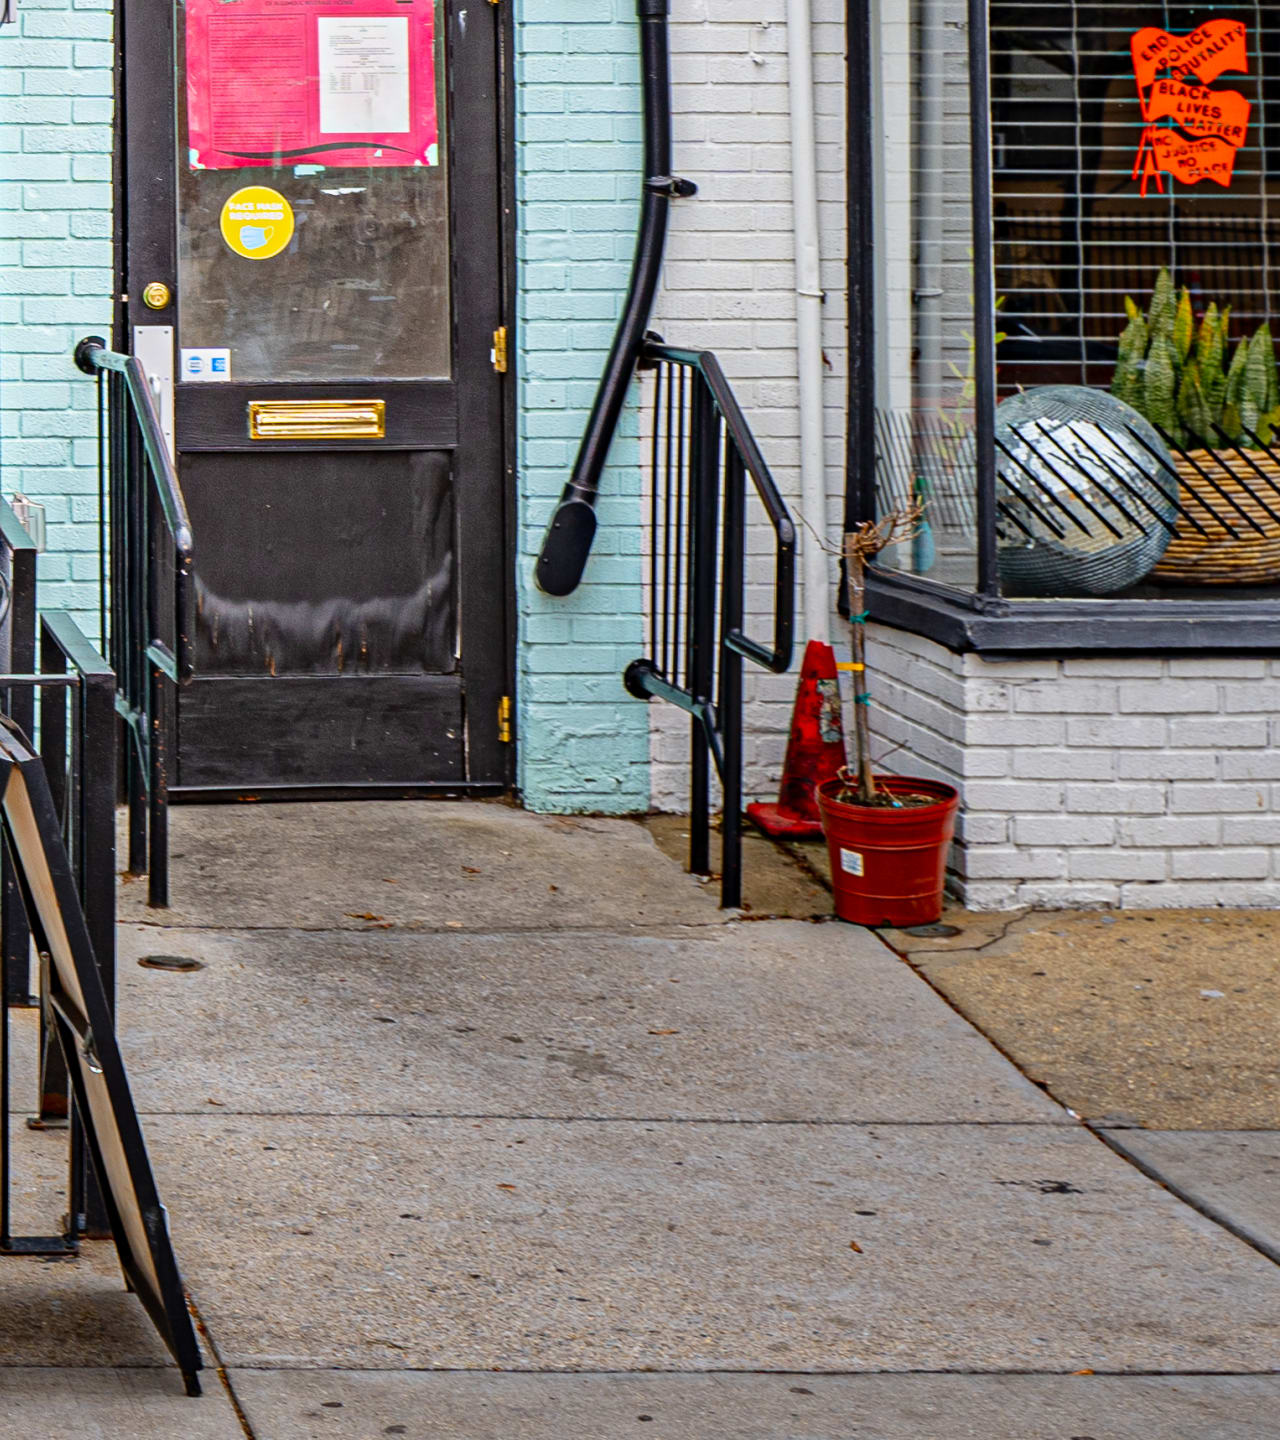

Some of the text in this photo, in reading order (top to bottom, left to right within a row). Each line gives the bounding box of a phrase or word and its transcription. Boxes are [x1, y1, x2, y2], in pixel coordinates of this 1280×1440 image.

[1141, 35, 1169, 61] END
[1157, 27, 1212, 71] POLICE
[1159, 82, 1211, 101] BLACK
[1176, 101, 1222, 119] LIVES
[1183, 117, 1243, 138] MATTER
[1177, 156, 1197, 168] NO
[228, 203, 254, 211] FACE
